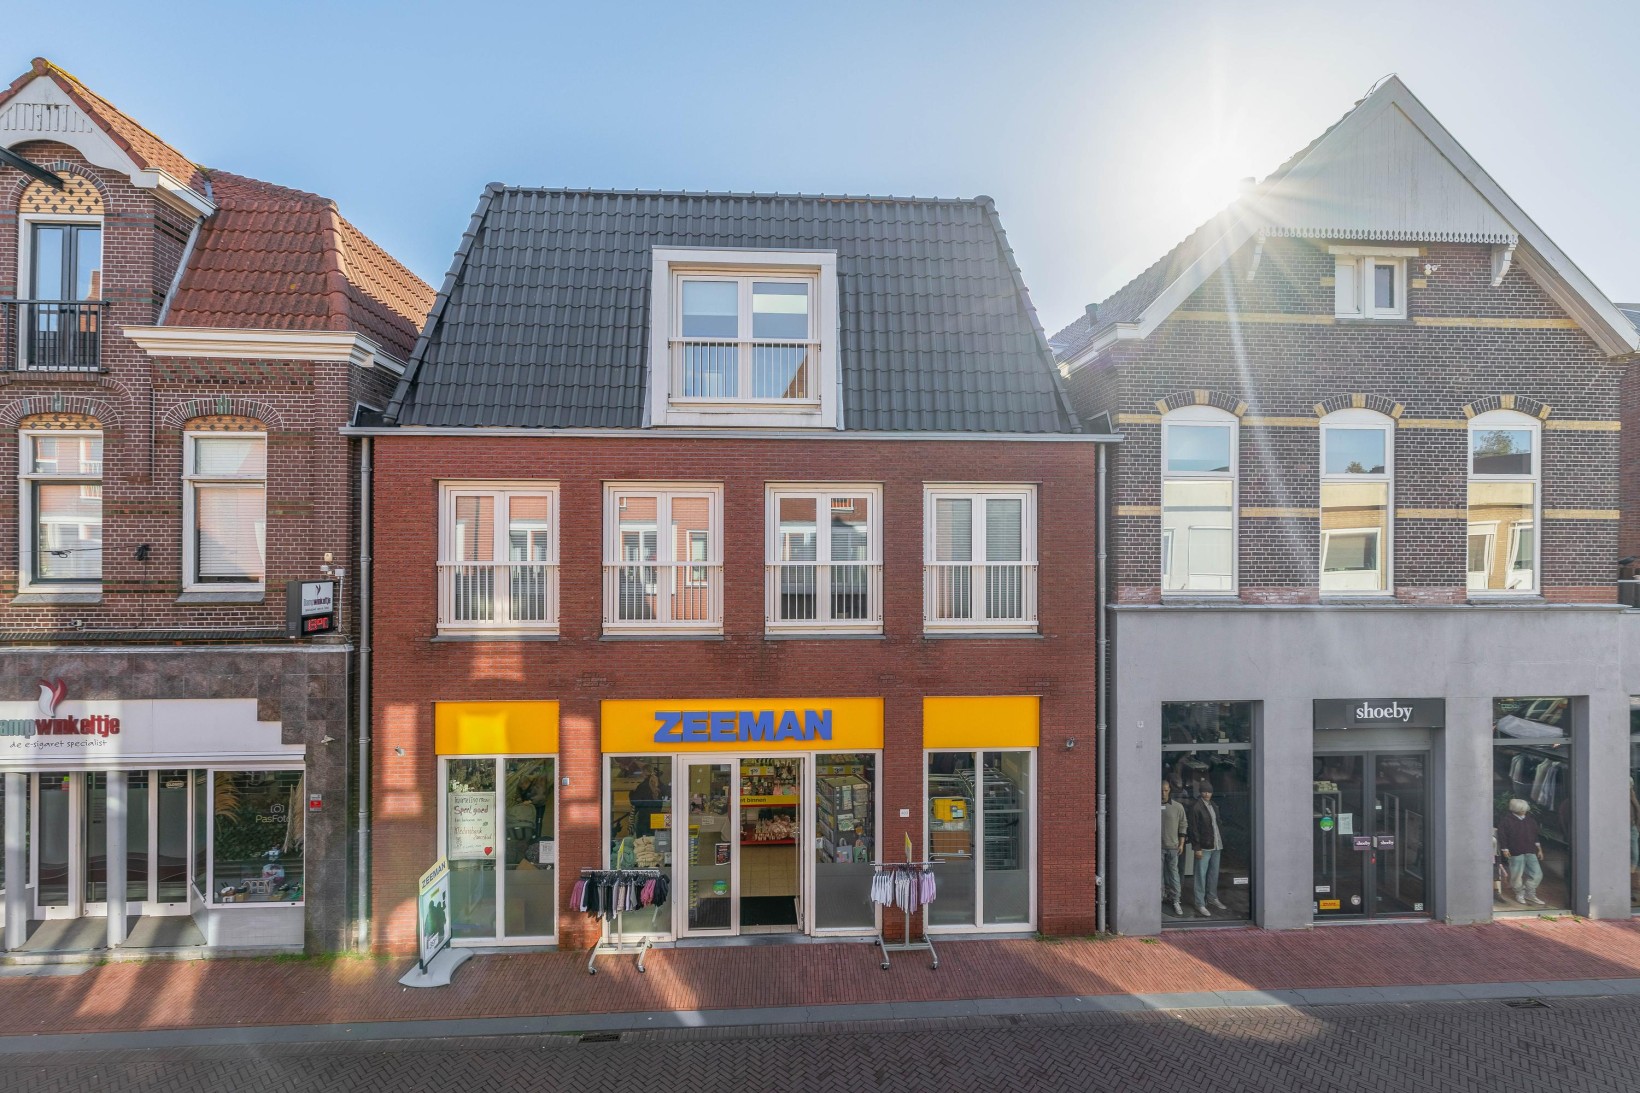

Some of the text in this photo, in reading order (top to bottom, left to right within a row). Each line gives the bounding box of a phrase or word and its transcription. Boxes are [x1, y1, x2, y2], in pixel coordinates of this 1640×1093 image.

[1356, 701, 1413, 722] shoeby
[654, 710, 832, 742] ZEEMAN
[25, 741, 64, 750] e-sigaret
[67, 739, 108, 748] specialist
[421, 861, 446, 889] ZEEMAN
[243, 880, 271, 894] OPEN
